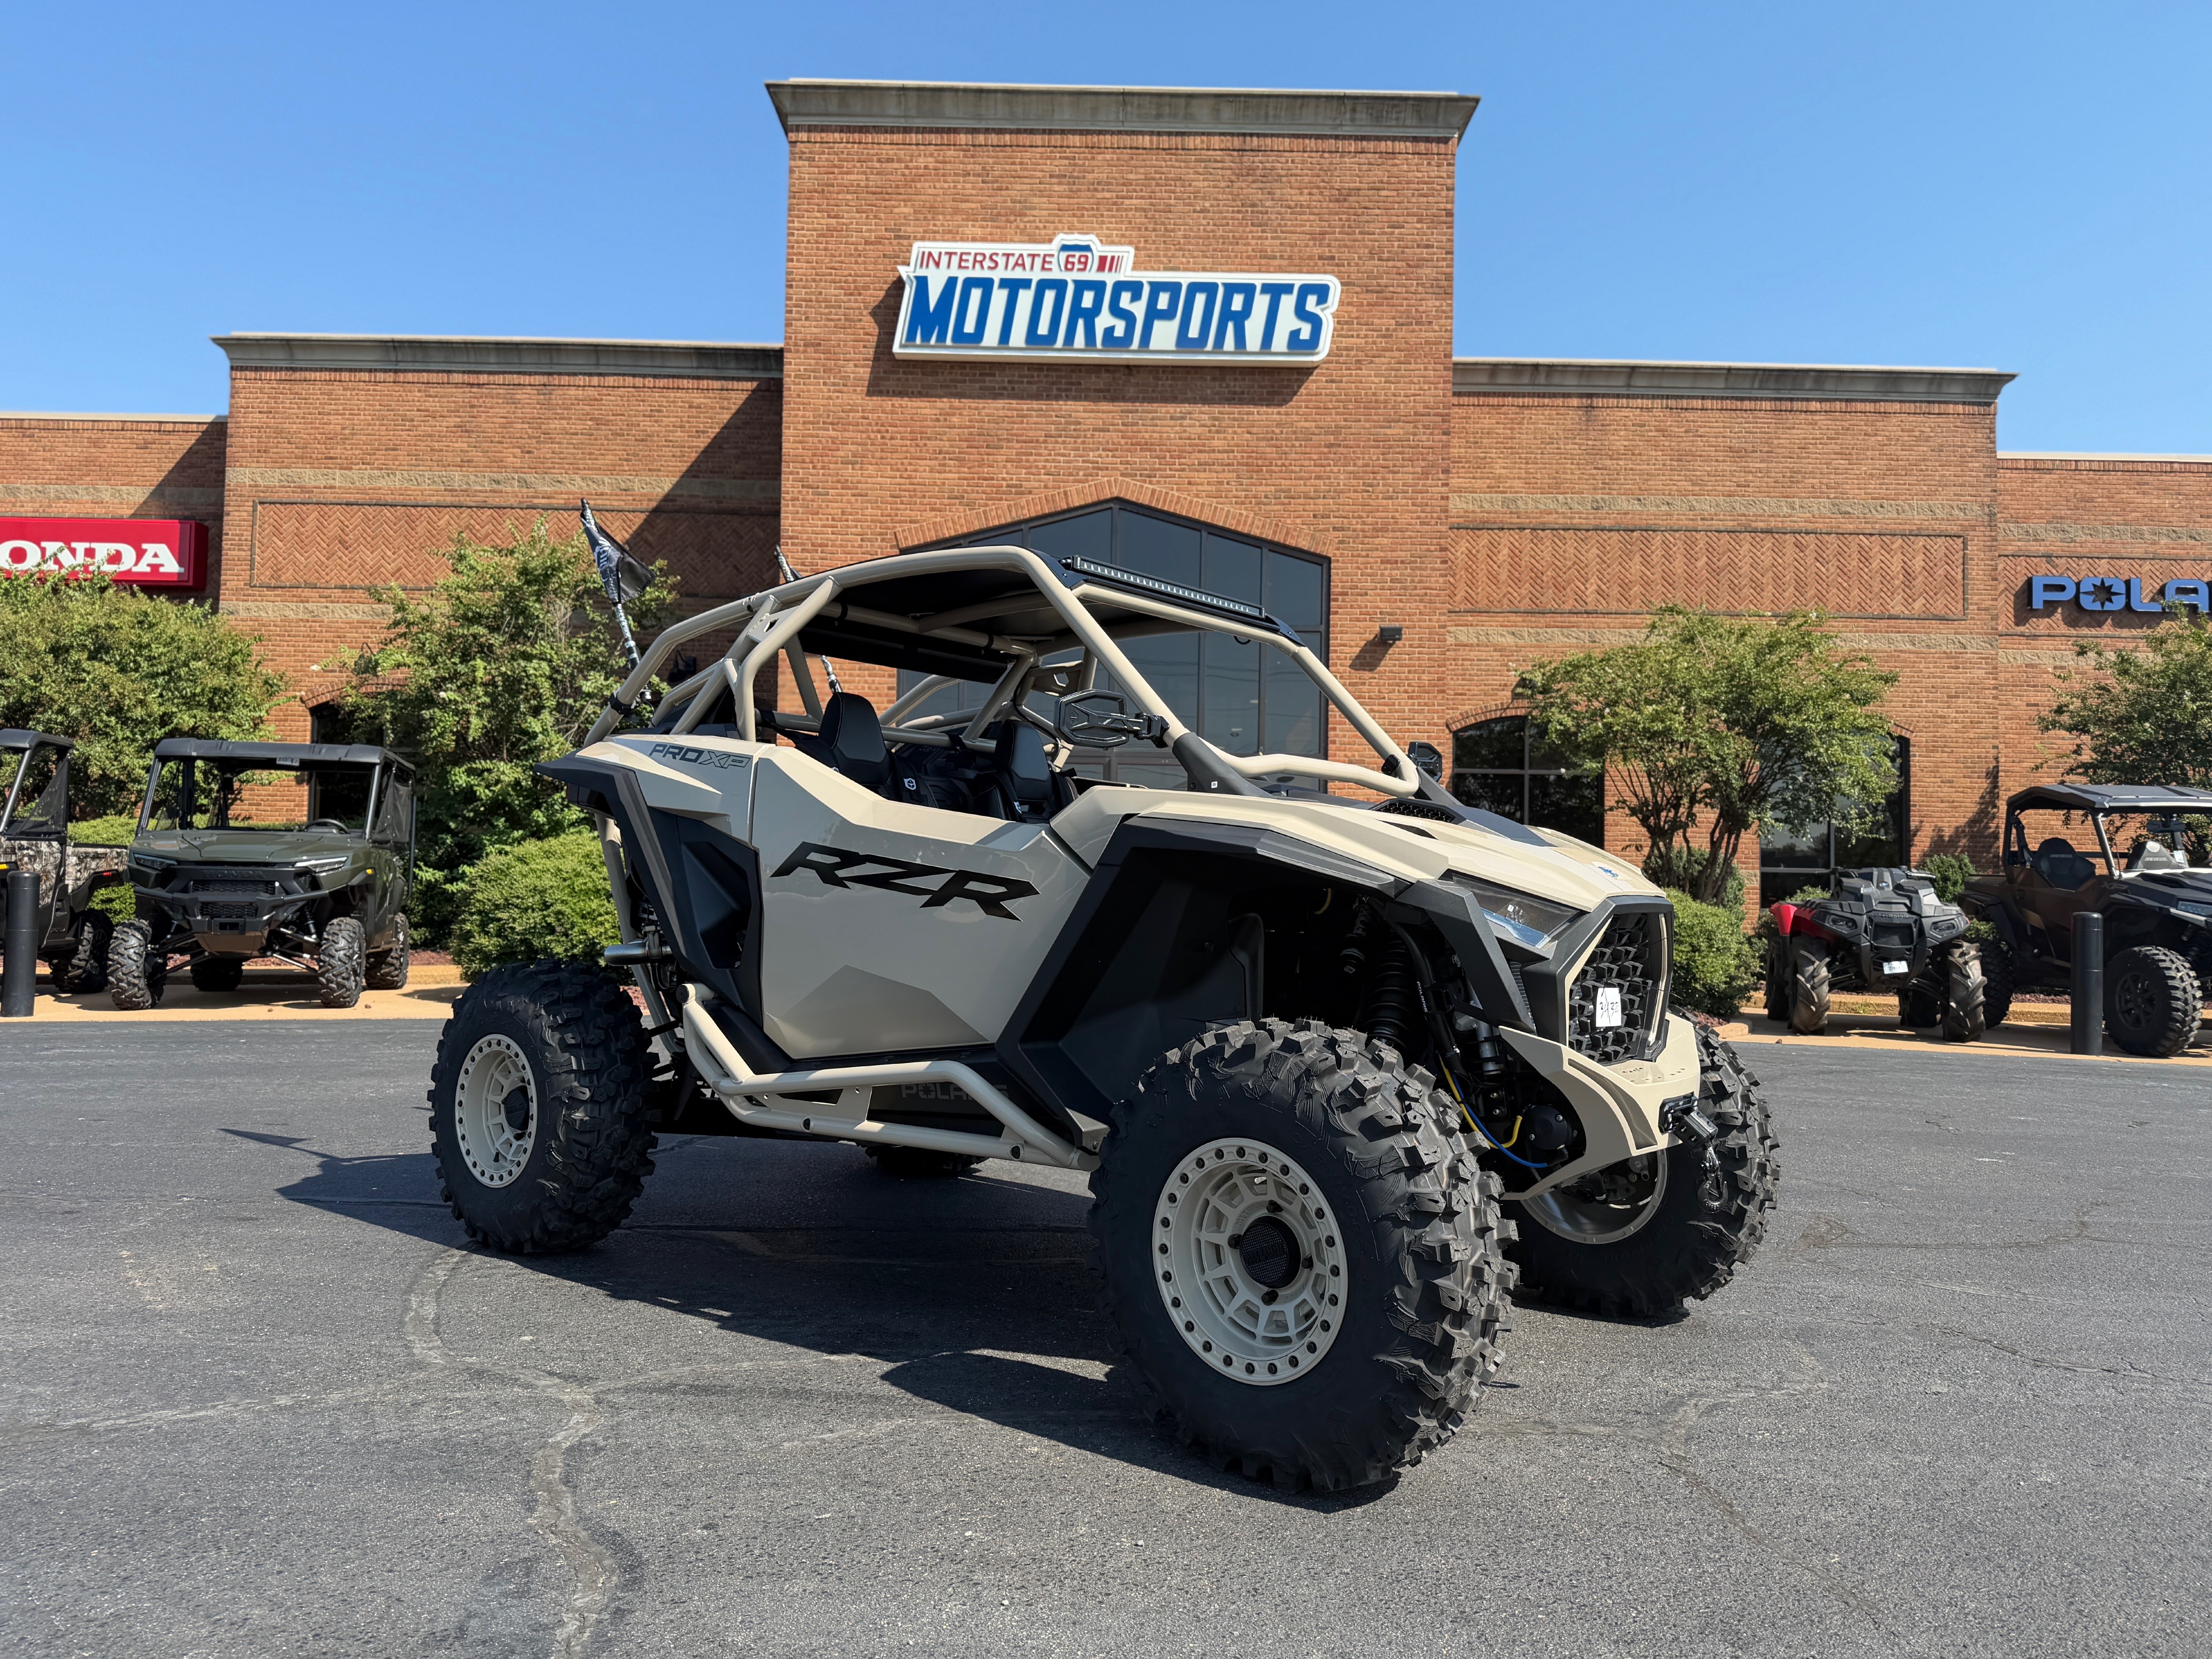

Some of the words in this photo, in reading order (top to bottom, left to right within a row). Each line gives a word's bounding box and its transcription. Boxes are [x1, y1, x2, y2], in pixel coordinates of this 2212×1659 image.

[919, 251, 1055, 272] INTERSTATE
[1064, 254, 1089, 272] 69
[902, 275, 1331, 352] MOTORSPORTS
[202, 870, 266, 879] HONDA
[769, 841, 1041, 922] RZR
[2099, 880, 2130, 890] XP
